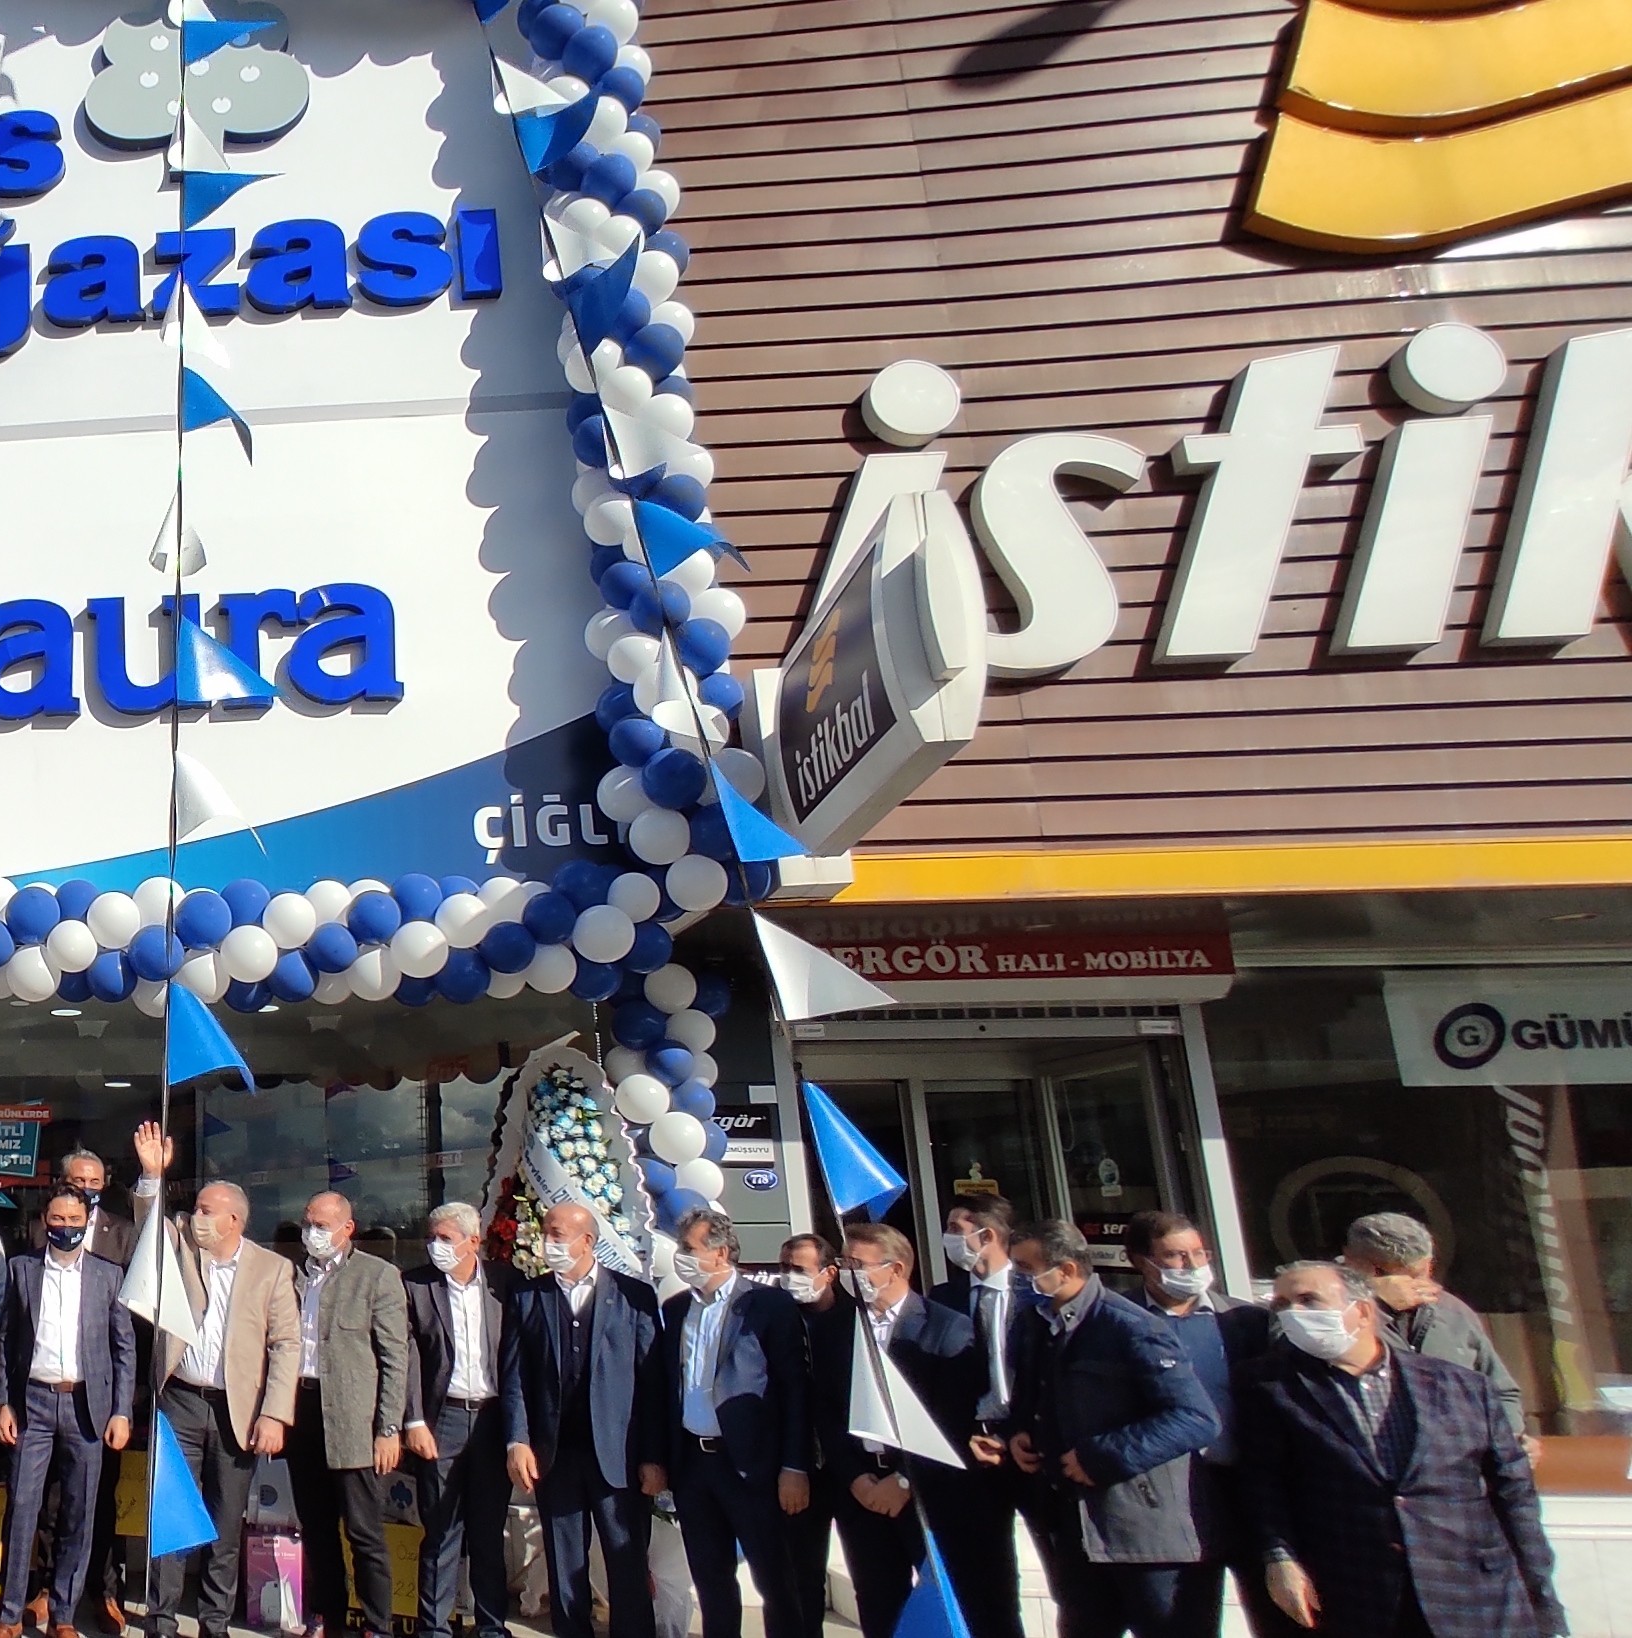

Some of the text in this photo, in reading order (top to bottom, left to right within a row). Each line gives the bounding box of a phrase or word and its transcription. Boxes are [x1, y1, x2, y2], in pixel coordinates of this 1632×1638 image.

[795, 669, 875, 808] istikbal
[473, 794, 630, 864] ÇİĞL
[822, 939, 990, 975] ERGÖR
[996, 954, 1067, 972] HALI
[1084, 945, 1212, 971] MOBİLYA
